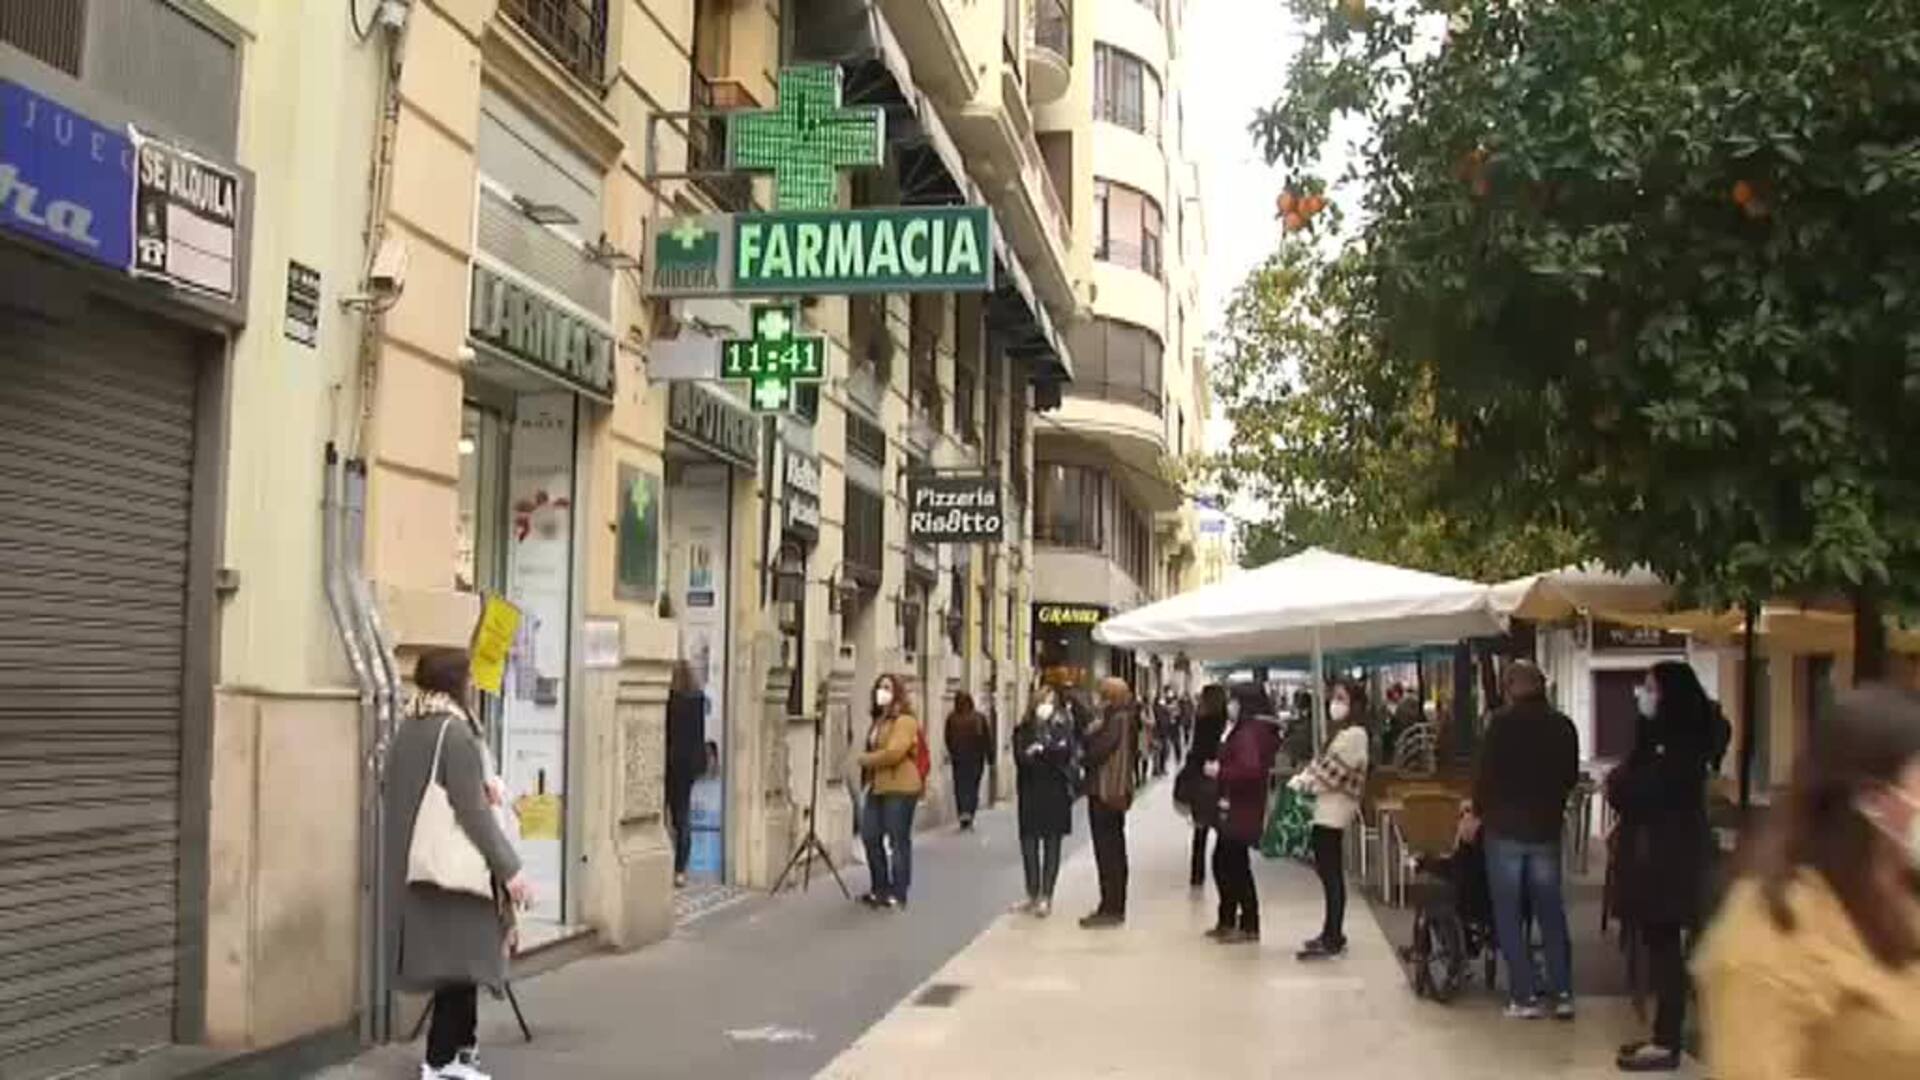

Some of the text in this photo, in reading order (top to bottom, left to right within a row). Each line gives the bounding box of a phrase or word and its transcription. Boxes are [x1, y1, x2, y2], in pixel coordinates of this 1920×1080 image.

[141, 149, 235, 219] SE ALQUILA
[738, 219, 980, 278] FARMACIA
[728, 343, 817, 372] 11:41
[916, 488, 995, 508] Pizzeria
[911, 509, 1000, 533] Risotto
